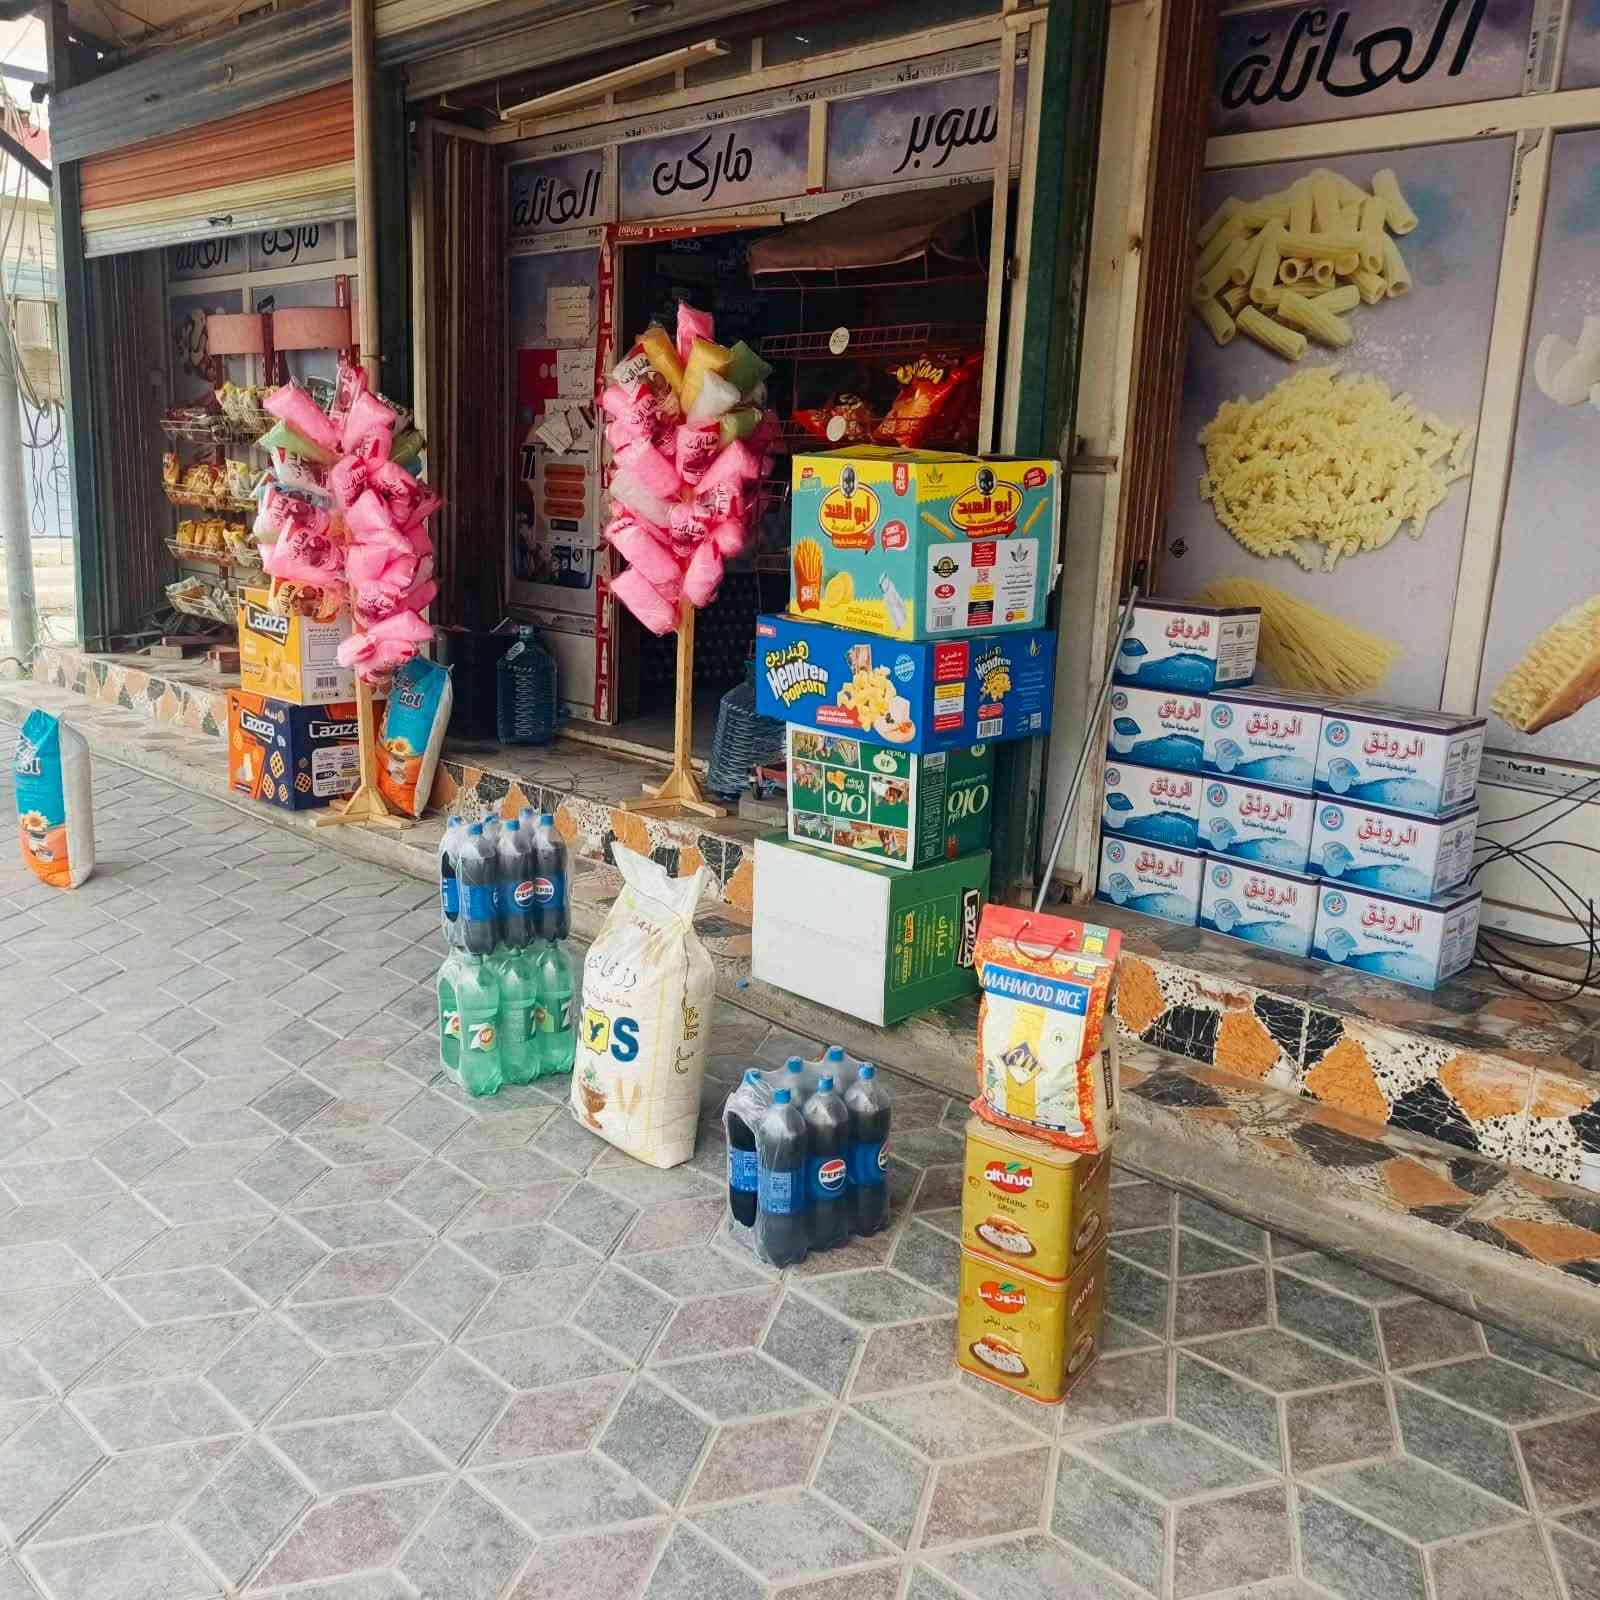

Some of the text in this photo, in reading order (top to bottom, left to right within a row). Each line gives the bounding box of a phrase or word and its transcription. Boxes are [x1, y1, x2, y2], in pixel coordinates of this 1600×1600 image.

[1222, 0, 1488, 109] العائلة
[512, 104, 998, 227] سوبر ماركت العائلة
[247, 606, 288, 634] Laziza
[1165, 617, 1211, 640] الرونق
[766, 660, 828, 701] Hendren
[975, 656, 1011, 680] Hendren
[240, 710, 275, 737] Laziza
[1158, 699, 1201, 721] الرونق
[1246, 712, 1302, 738] الرونق
[1362, 731, 1424, 759] الرونق
[1150, 777, 1193, 798] الرونق
[1239, 793, 1292, 821] الرونق
[1358, 816, 1419, 847] الرونق
[1135, 851, 1185, 878] الرونق
[1243, 878, 1298, 904] الرونق
[1361, 904, 1423, 932] الرونق
[984, 971, 1082, 1010] MAHMOOD RICE
[988, 1191, 1027, 1209] Vegetable
